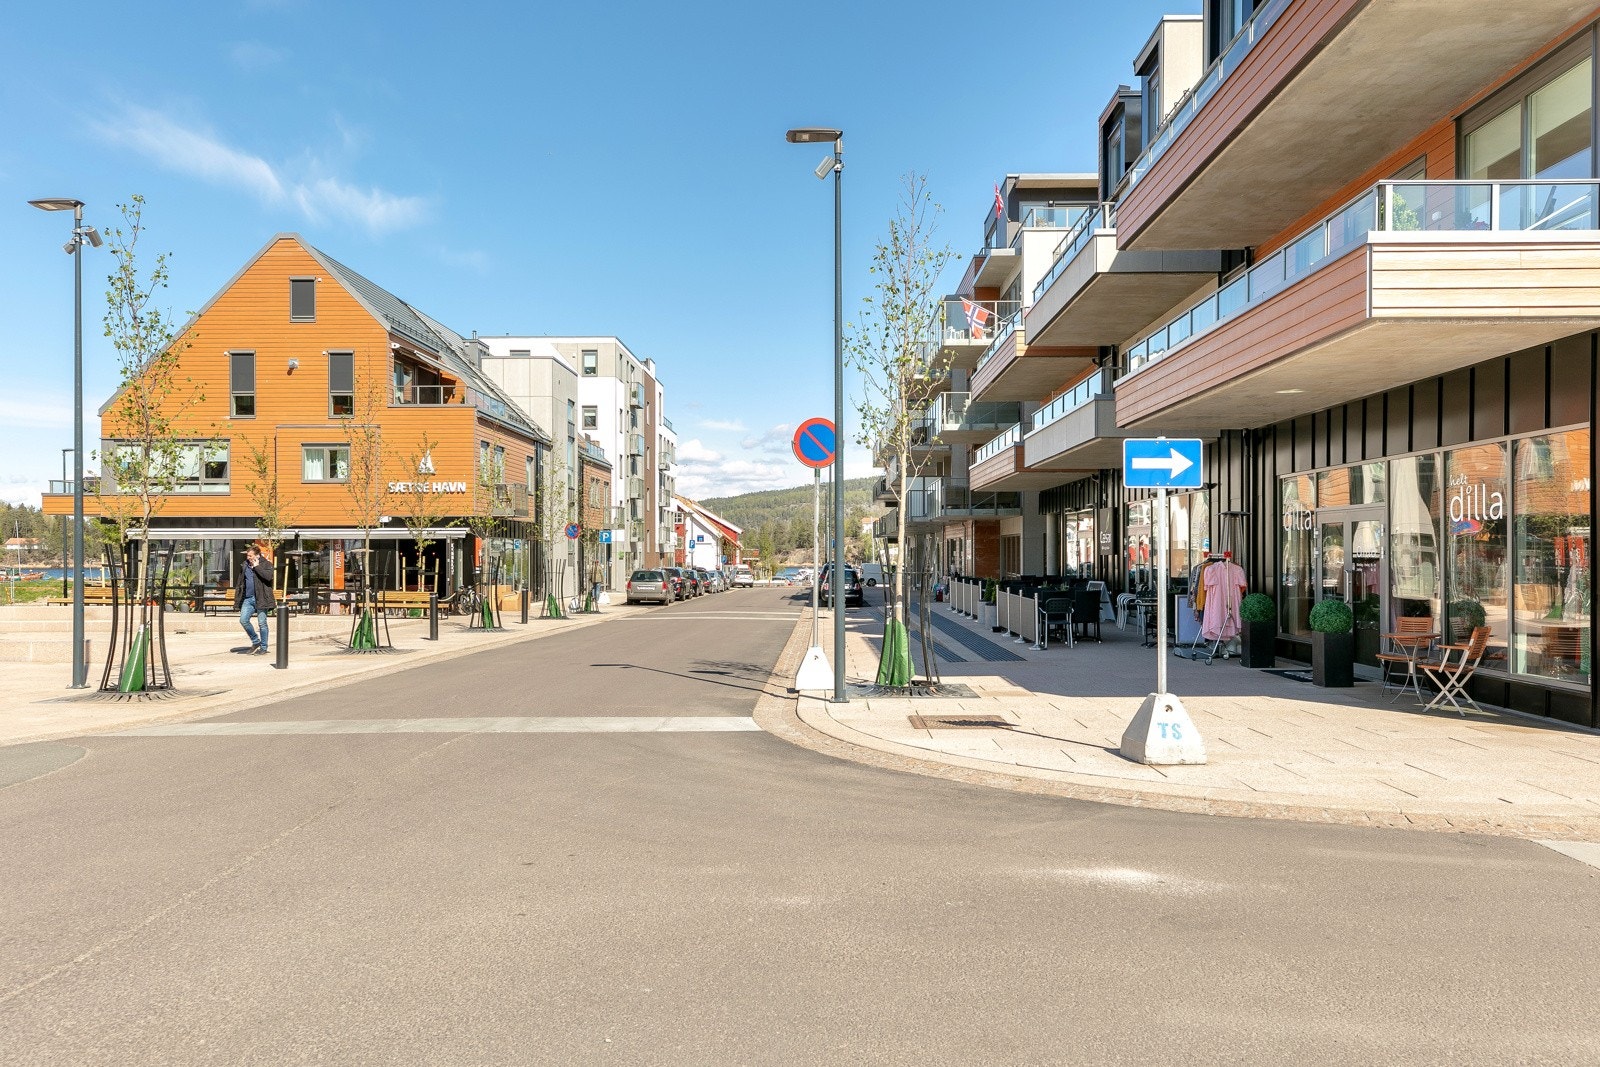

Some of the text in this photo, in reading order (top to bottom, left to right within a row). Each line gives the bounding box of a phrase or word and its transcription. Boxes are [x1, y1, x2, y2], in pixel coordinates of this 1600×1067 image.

[1450, 473, 1468, 486] helt
[432, 482, 466, 493] HAVN
[1450, 484, 1503, 522] dilla
[603, 533, 610, 541] P
[1157, 722, 1182, 740] TS
